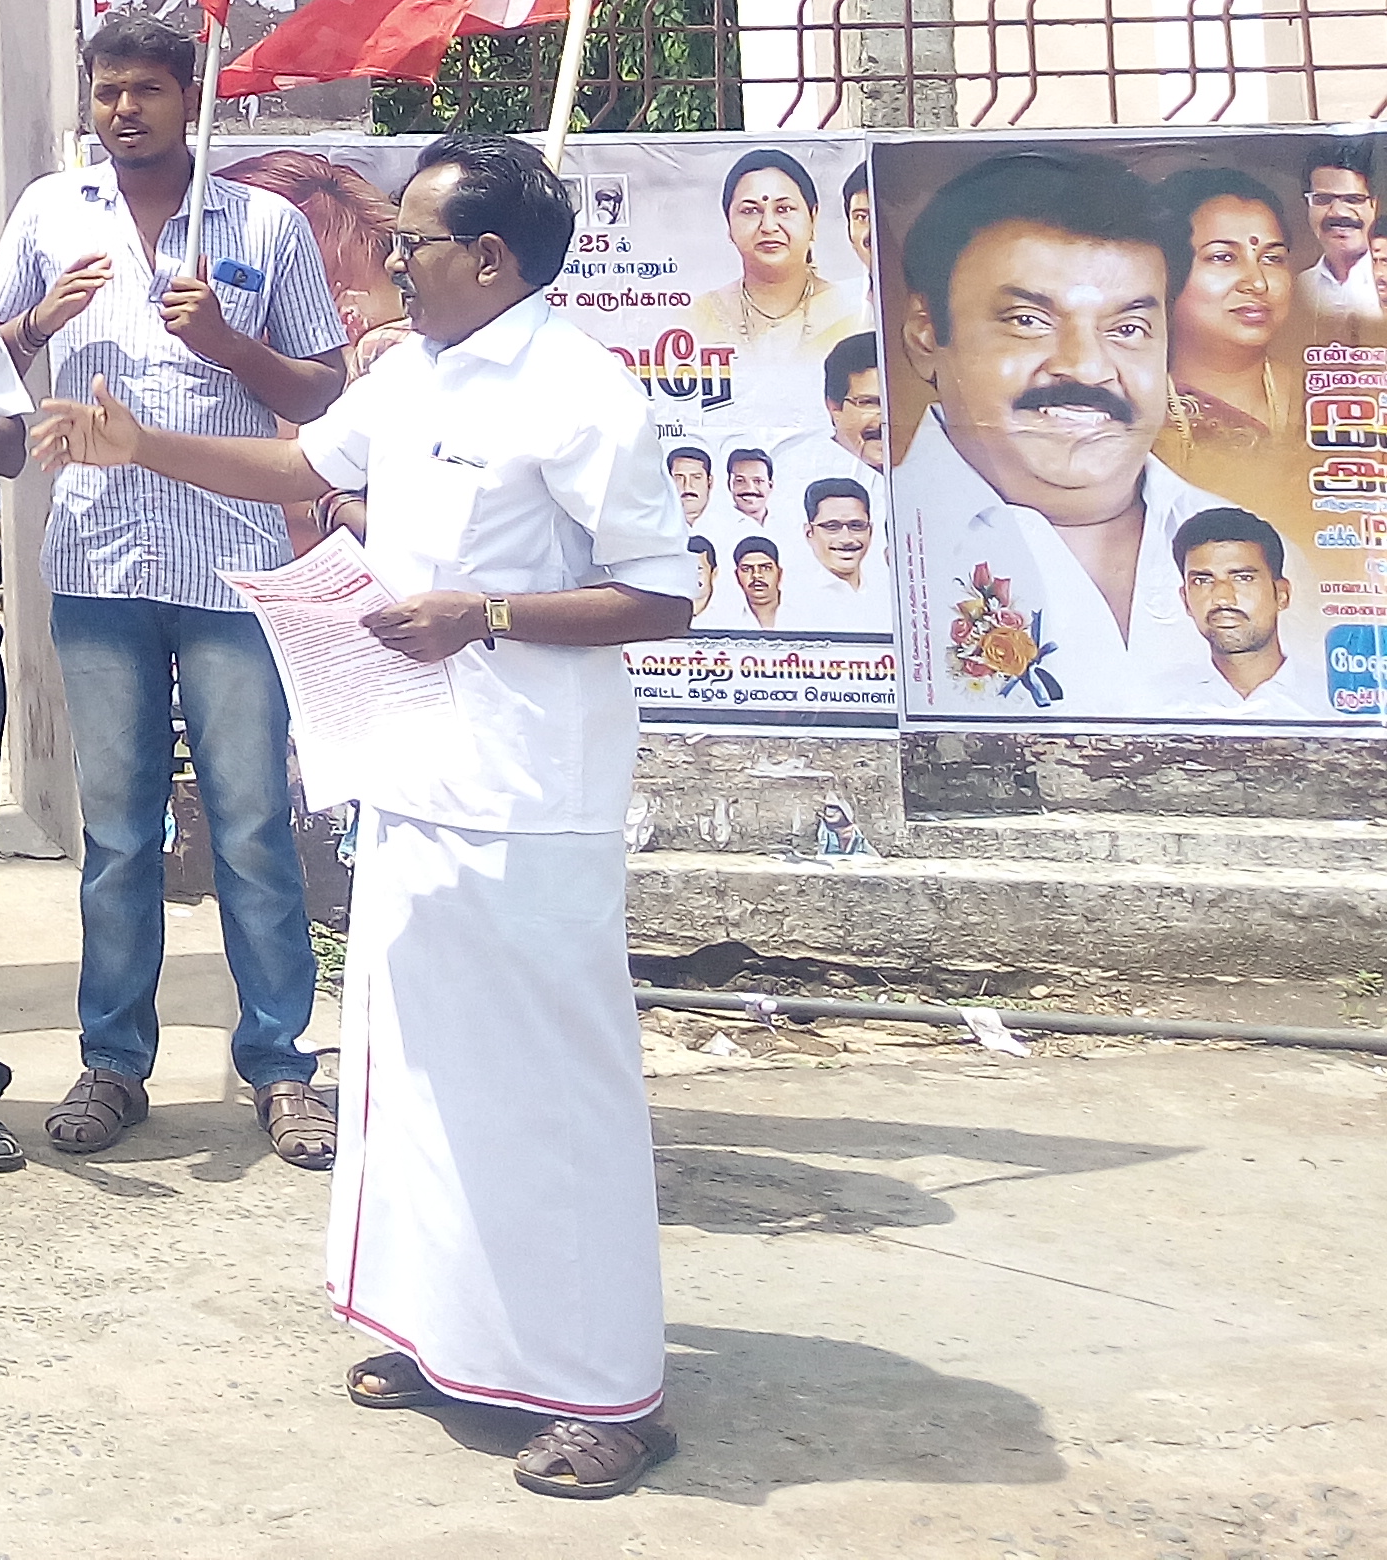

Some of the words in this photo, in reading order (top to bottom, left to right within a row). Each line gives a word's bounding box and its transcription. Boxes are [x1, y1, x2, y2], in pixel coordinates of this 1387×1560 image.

[579, 233, 611, 253] 25
[612, 257, 679, 280] காணும்
[576, 287, 692, 313] வருங்கால
[740, 652, 897, 682] பெரியசாமி
[688, 687, 728, 703] கழக
[733, 688, 798, 706] துணை
[804, 687, 897, 706] செயலாளர்
